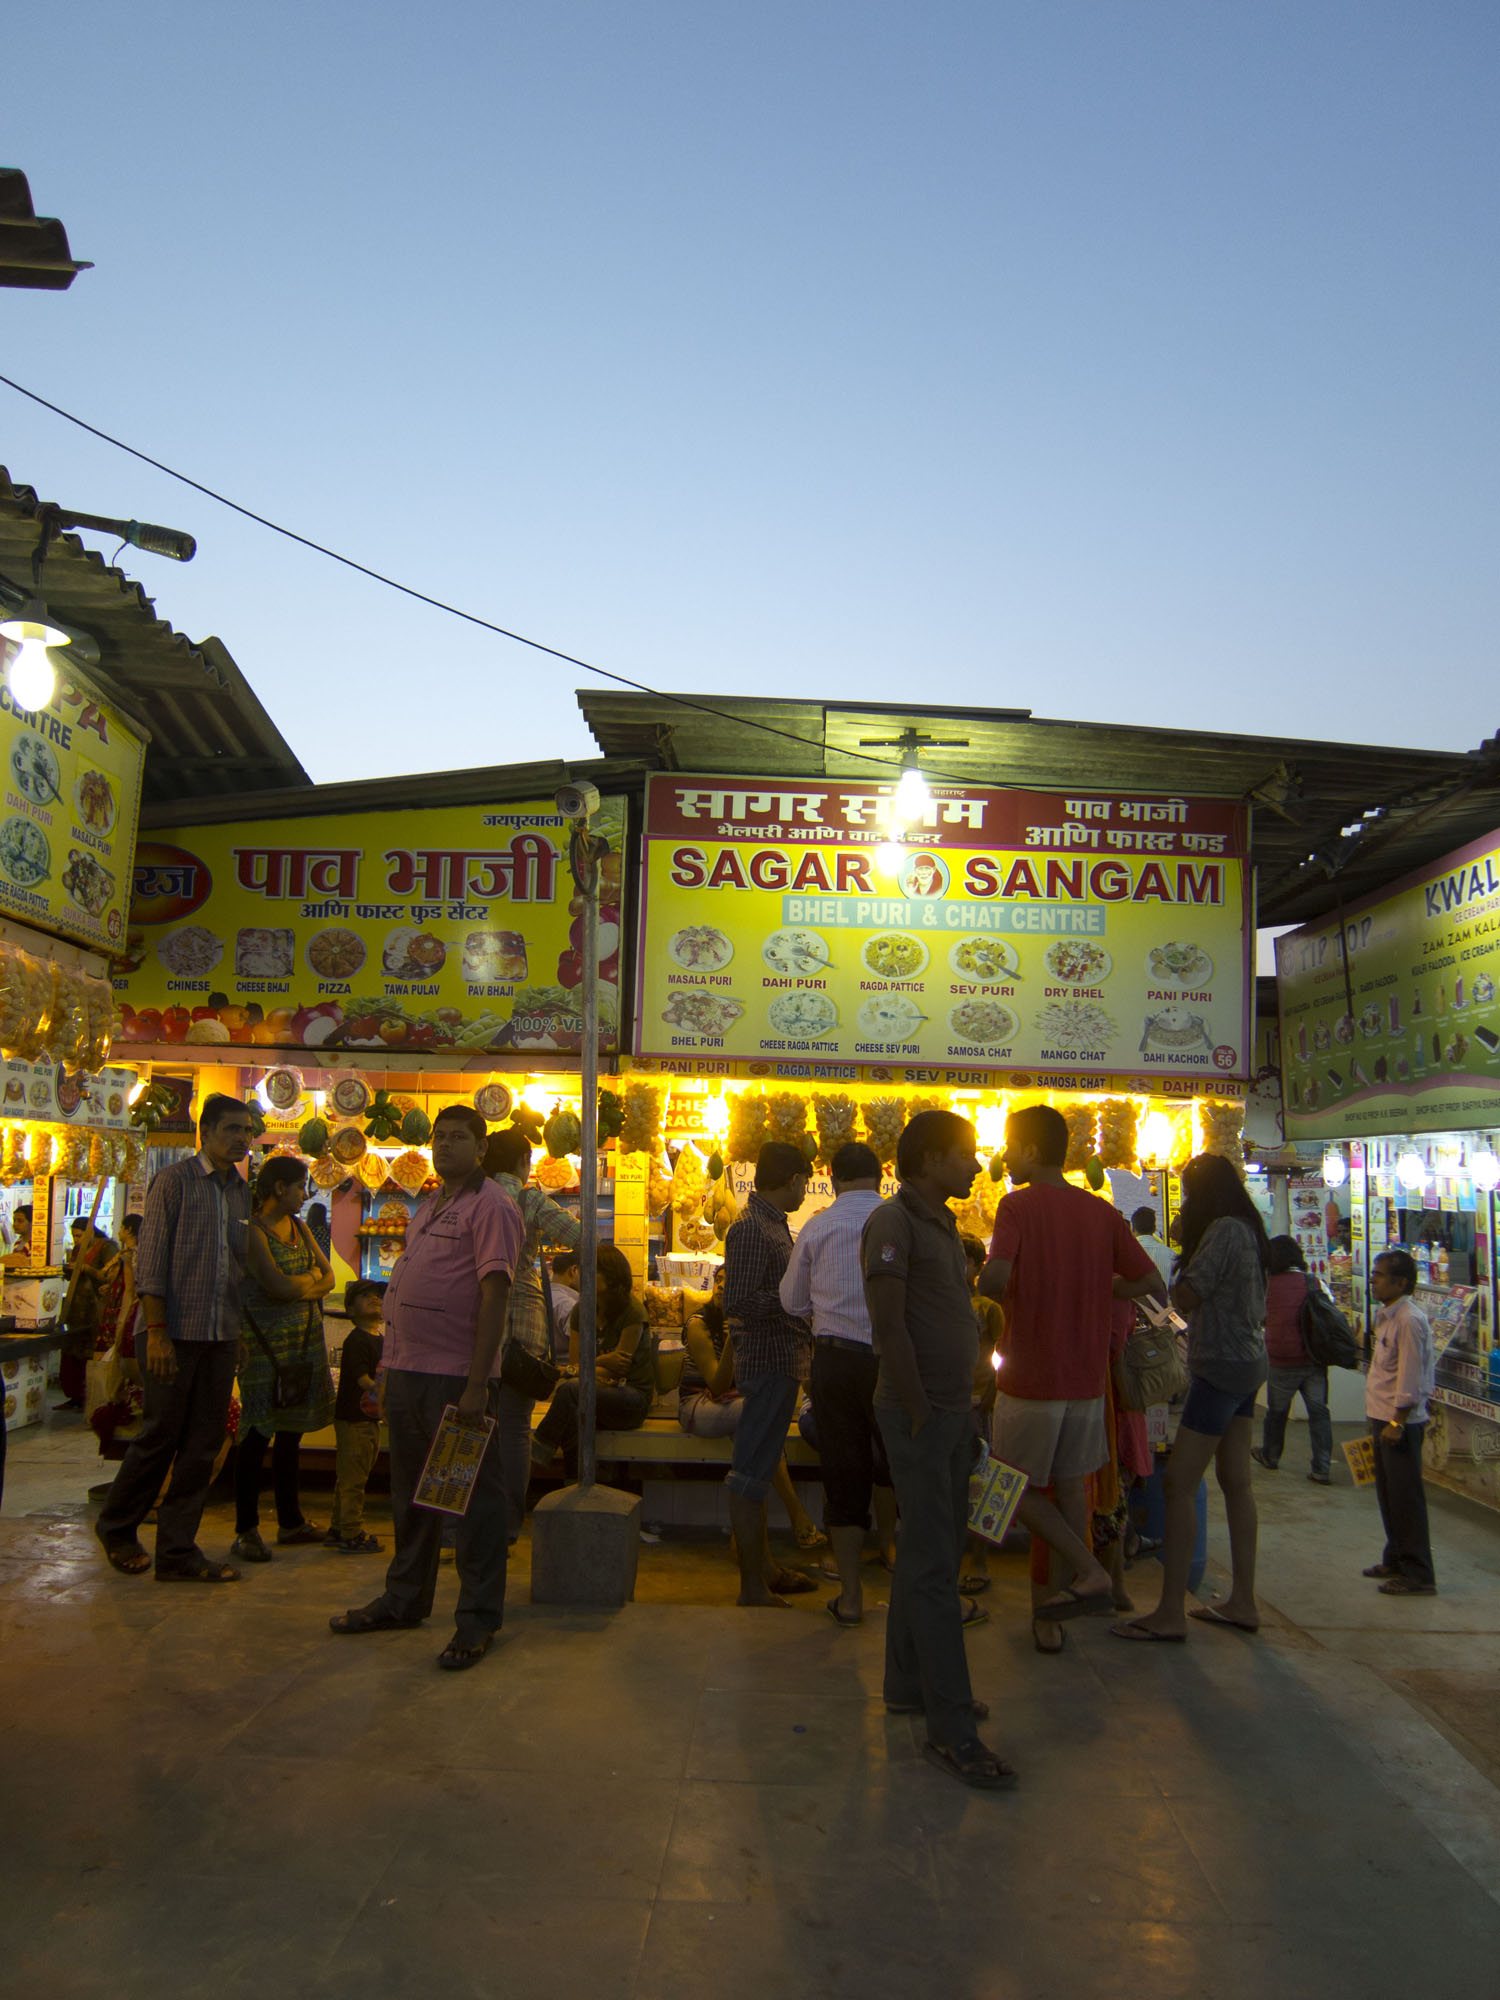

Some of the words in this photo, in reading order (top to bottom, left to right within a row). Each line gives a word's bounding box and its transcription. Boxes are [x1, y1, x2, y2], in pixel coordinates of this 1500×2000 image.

[675, 788, 829, 823] सागर
[840, 786, 989, 829] संम
[1063, 799, 1112, 820] पाव
[1119, 798, 1189, 823] भाजी
[31, 804, 53, 826] PURI
[71, 825, 97, 848] MASALA
[787, 825, 844, 841] आणि
[1025, 821, 1100, 848] आणि
[1106, 828, 1177, 851] फास्ट
[231, 846, 363, 899] पाव
[382, 833, 561, 903] भाजी
[671, 846, 878, 893] SAGAR
[964, 855, 1225, 905] SANGAM
[299, 900, 350, 921] आणि
[355, 902, 405, 921] फास्ट
[409, 903, 443, 925] फुड
[788, 899, 850, 924] BHEL
[856, 902, 912, 926] PURI
[921, 904, 938, 927] &
[945, 905, 1005, 929] CHAT
[1011, 906, 1100, 932] CENTRE
[108, 918, 121, 937] 46
[1300, 935, 1328, 972] TIP
[1333, 916, 1373, 958] TOP
[1422, 937, 1445, 955] ZAM
[1447, 928, 1472, 947] ZAM
[166, 980, 211, 992] CHINESE
[235, 981, 266, 993] CHEESE
[267, 982, 290, 993] BHAJI
[668, 975, 708, 986] MASALA
[709, 975, 732, 987] PURI
[762, 977, 793, 988] DAHI
[796, 979, 827, 989] PURI
[859, 981, 888, 991] RAGDA
[890, 982, 925, 993] PATTICE
[318, 982, 352, 995] PIZZA
[384, 983, 409, 996] TAWA
[410, 984, 440, 996] PULAV
[467, 985, 485, 997] PAV
[486, 985, 514, 997] BHAJI
[949, 984, 977, 995] SEV
[981, 986, 1015, 997] PURI
[1043, 987, 1071, 998] DRY
[1072, 988, 1105, 999] BHEL
[1147, 990, 1178, 1001] PANI
[1181, 991, 1213, 1003] PURI
[513, 1016, 555, 1034] 100%
[671, 1036, 698, 1047] BHEL
[699, 1037, 725, 1048] PURI
[759, 1039, 786, 1050] CHEESE
[786, 1040, 811, 1051] RAGDA
[811, 1041, 839, 1052] PATTICE
[854, 1042, 885, 1053] CHEESE
[885, 1043, 901, 1054] SEV
[901, 1044, 920, 1055] PURI
[947, 1045, 986, 1057] SAMOSA
[987, 1047, 1013, 1058] CHAT
[1040, 1049, 1078, 1060] MANGO
[1079, 1050, 1106, 1062] CHAT
[1143, 1052, 1165, 1063] DAHI
[1167, 1053, 1209, 1065] KACHORI
[660, 1060, 692, 1074] PANI
[696, 1061, 730, 1075] PURI
[1217, 1055, 1233, 1067] 56
[776, 1063, 811, 1077] RAGDA
[813, 1065, 857, 1079] PATTICE
[904, 1069, 940, 1082] SEV
[945, 1070, 989, 1085] PURI
[1036, 1075, 1078, 1089] SAMOSA
[1079, 1076, 1107, 1091] CHAT
[1162, 1079, 1199, 1094] DAHI
[1204, 1081, 1242, 1096] PURI
[264, 1121, 299, 1129] CHINESE
